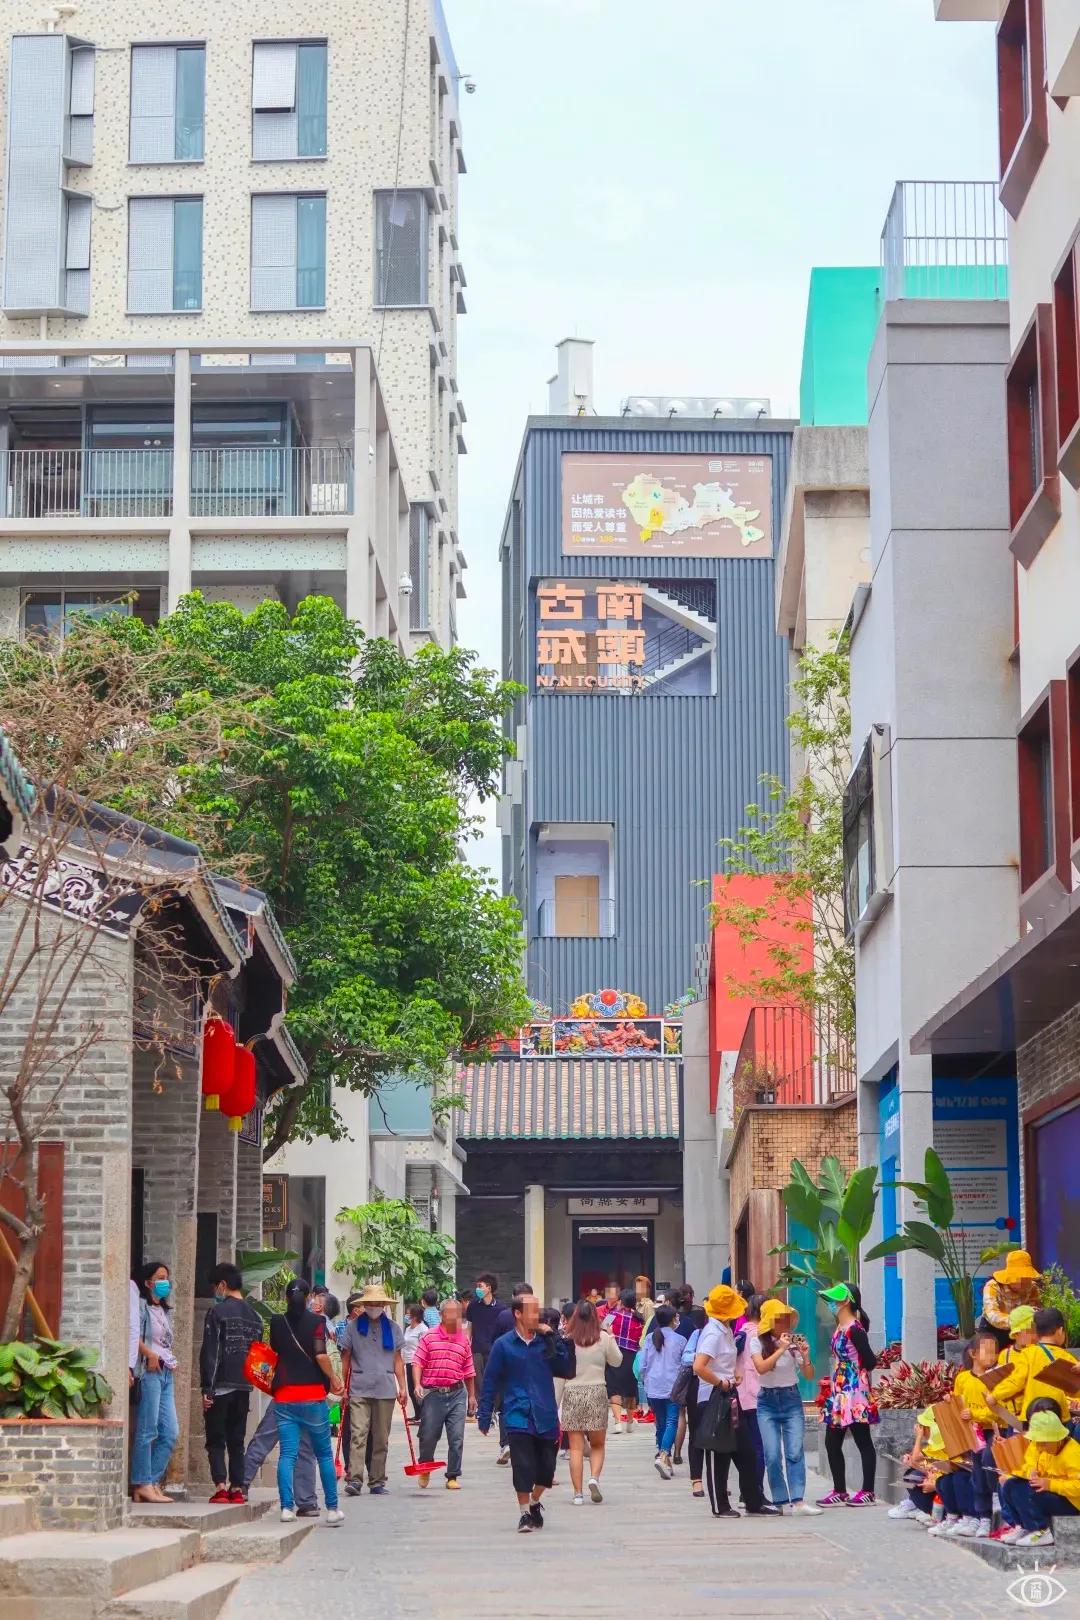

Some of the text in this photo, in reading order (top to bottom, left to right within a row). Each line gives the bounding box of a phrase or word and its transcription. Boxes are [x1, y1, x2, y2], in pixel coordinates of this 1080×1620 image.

[571, 493, 604, 505] 让城市
[571, 507, 627, 519] 因热爱读书
[571, 521, 626, 533] 而受人尊重
